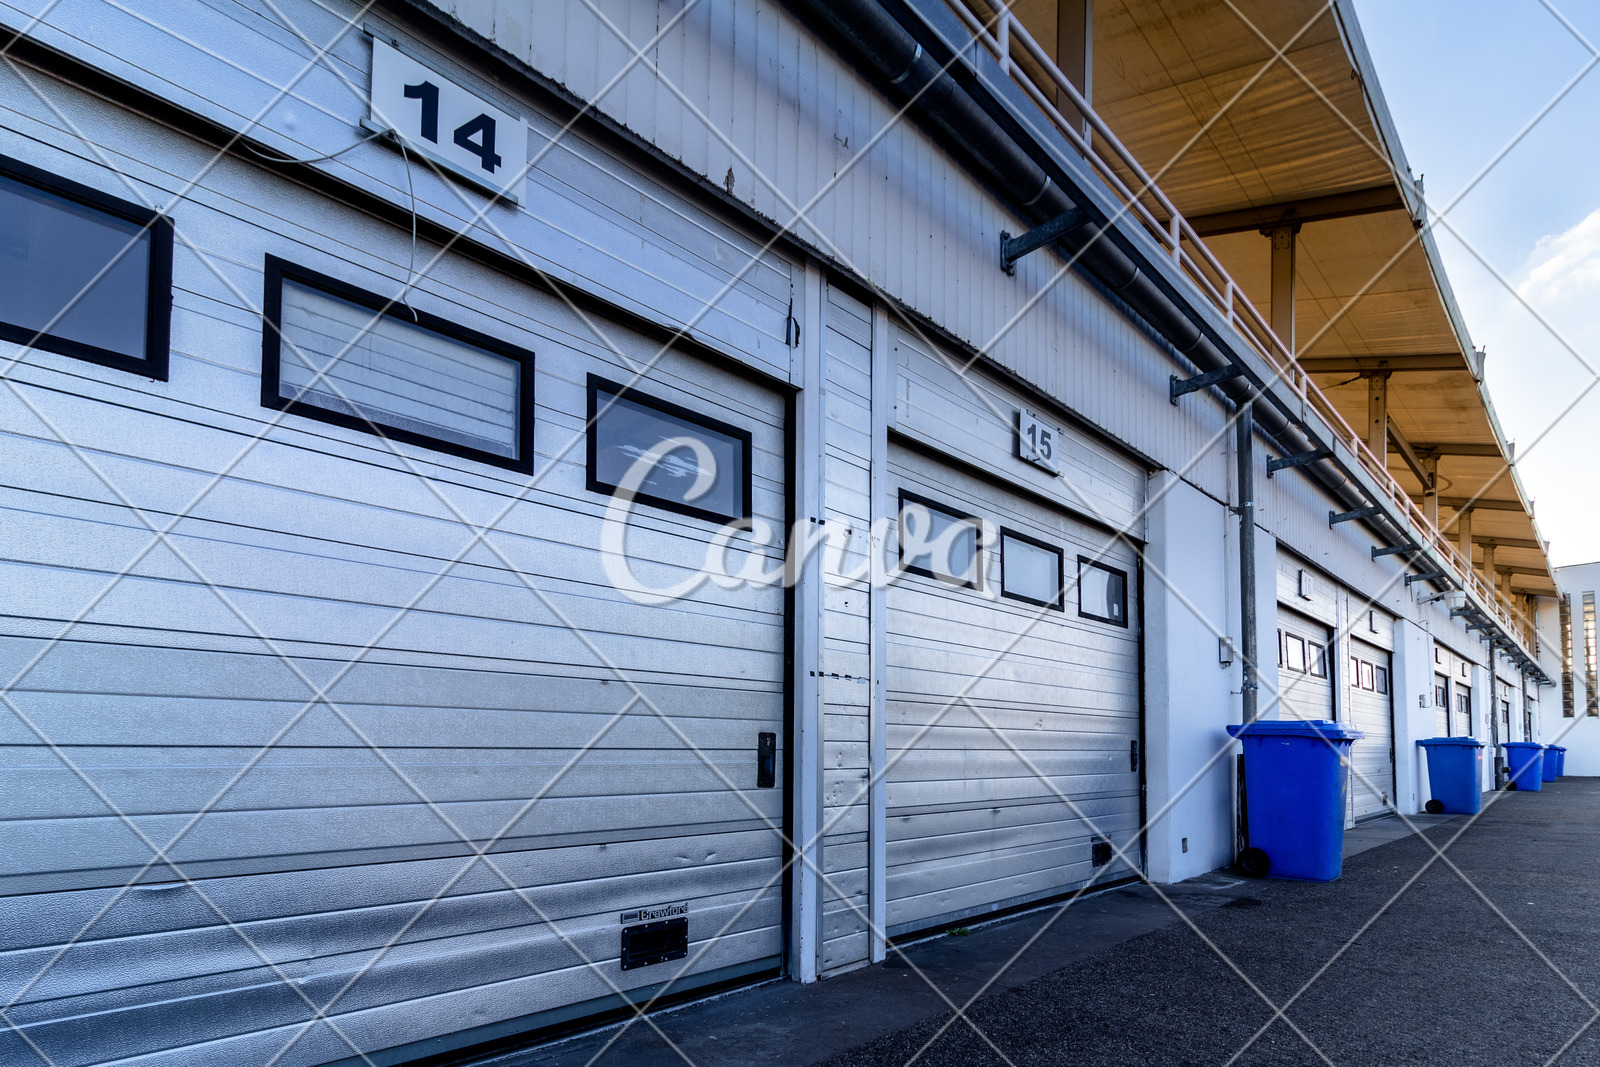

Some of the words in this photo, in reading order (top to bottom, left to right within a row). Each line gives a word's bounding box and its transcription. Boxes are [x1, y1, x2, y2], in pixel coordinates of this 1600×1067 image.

[403, 80, 502, 175] 14
[1027, 423, 1052, 461] 15
[640, 902, 689, 920] Crawford
